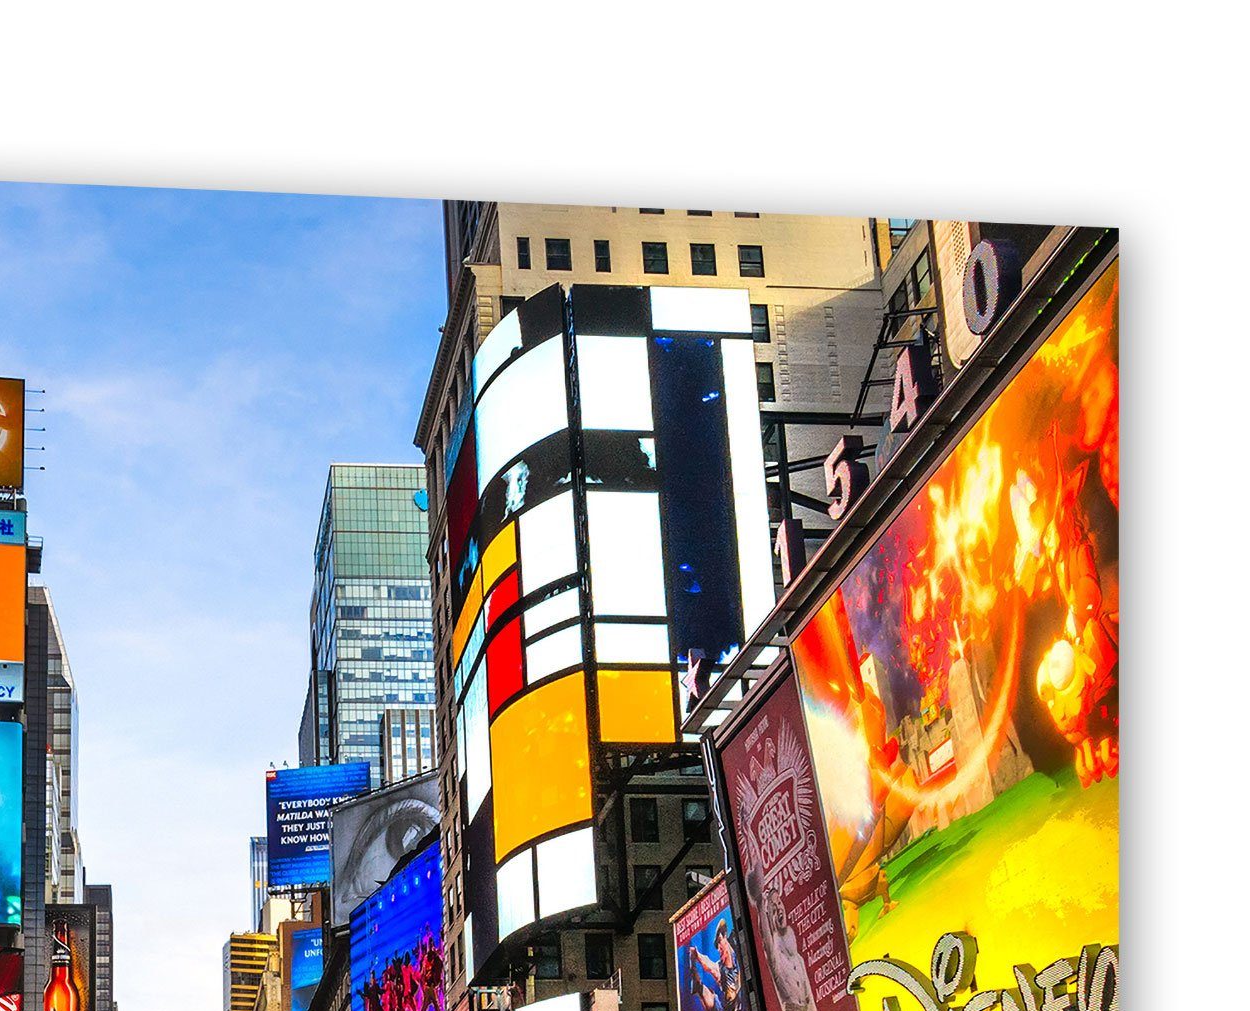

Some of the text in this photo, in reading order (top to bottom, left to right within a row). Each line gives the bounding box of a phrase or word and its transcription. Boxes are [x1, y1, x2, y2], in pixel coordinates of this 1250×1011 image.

[277, 811, 313, 821] MATILDA
[281, 821, 326, 833] THEY JUST
[758, 791, 790, 845] GREAT
[280, 833, 329, 845] KNOW HOW
[761, 813, 797, 870] COMET
[797, 913, 811, 936] THE
[814, 951, 845, 984] ORIGINAL
